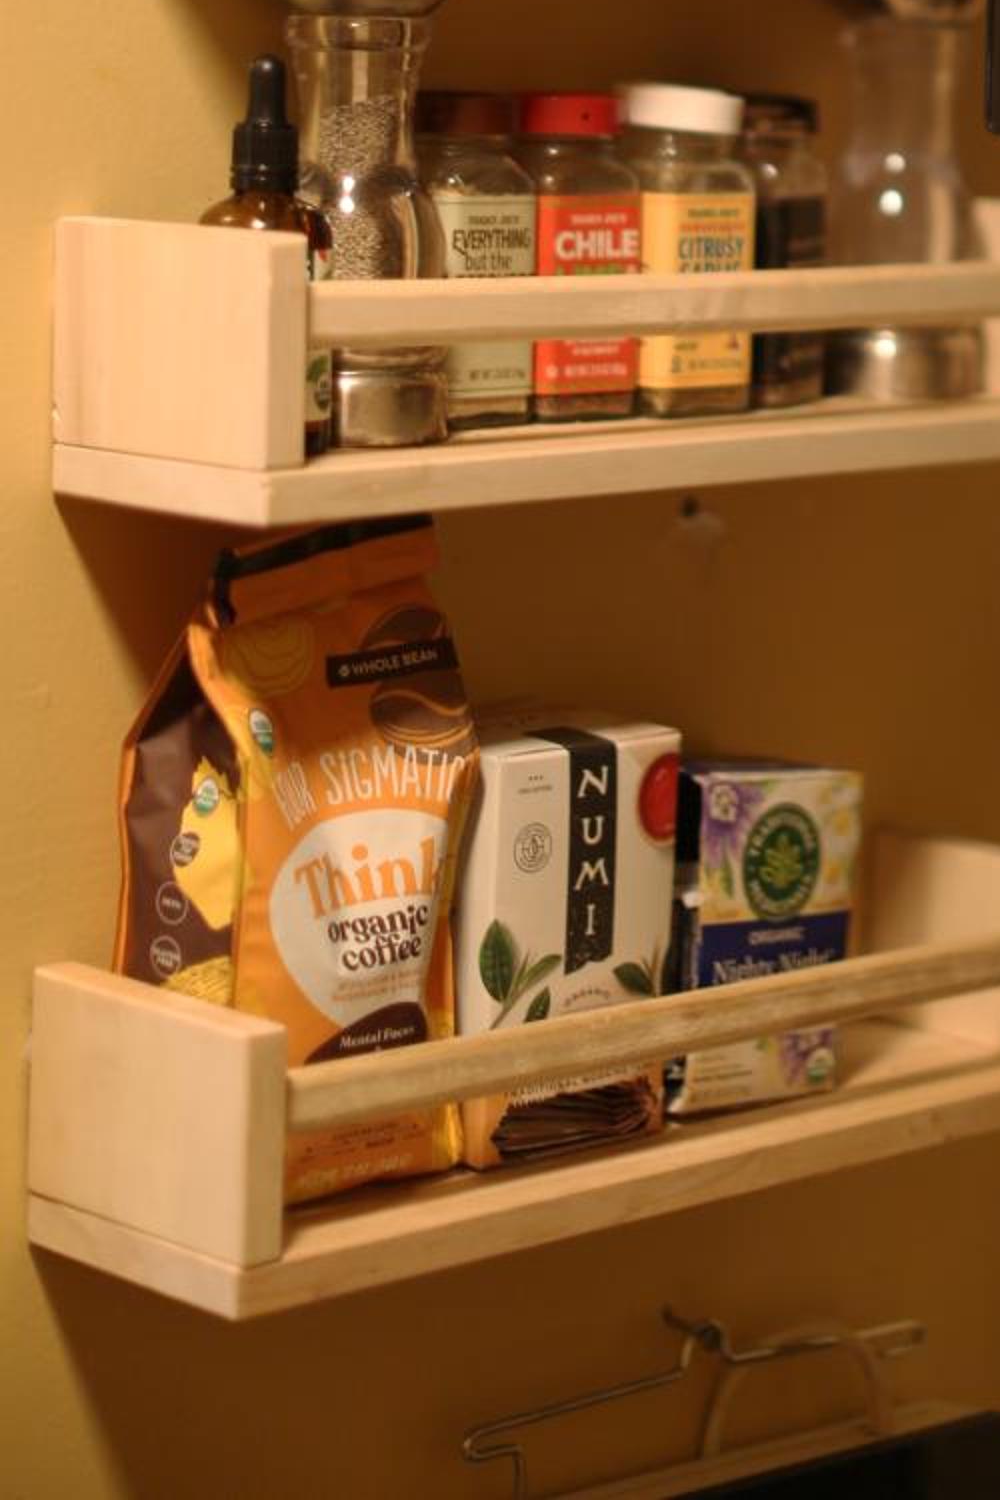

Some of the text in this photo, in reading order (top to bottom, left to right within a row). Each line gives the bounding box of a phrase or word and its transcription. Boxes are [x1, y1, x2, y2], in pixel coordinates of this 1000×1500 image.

[452, 227, 531, 251] EVERYTHING
[555, 229, 640, 261] CHILE
[351, 648, 439, 676] WHOLE BEAN
[574, 764, 611, 937] NUMI
[327, 904, 429, 944] organic
[341, 933, 422, 972] coffee
[340, 1027, 382, 1049] Mental
